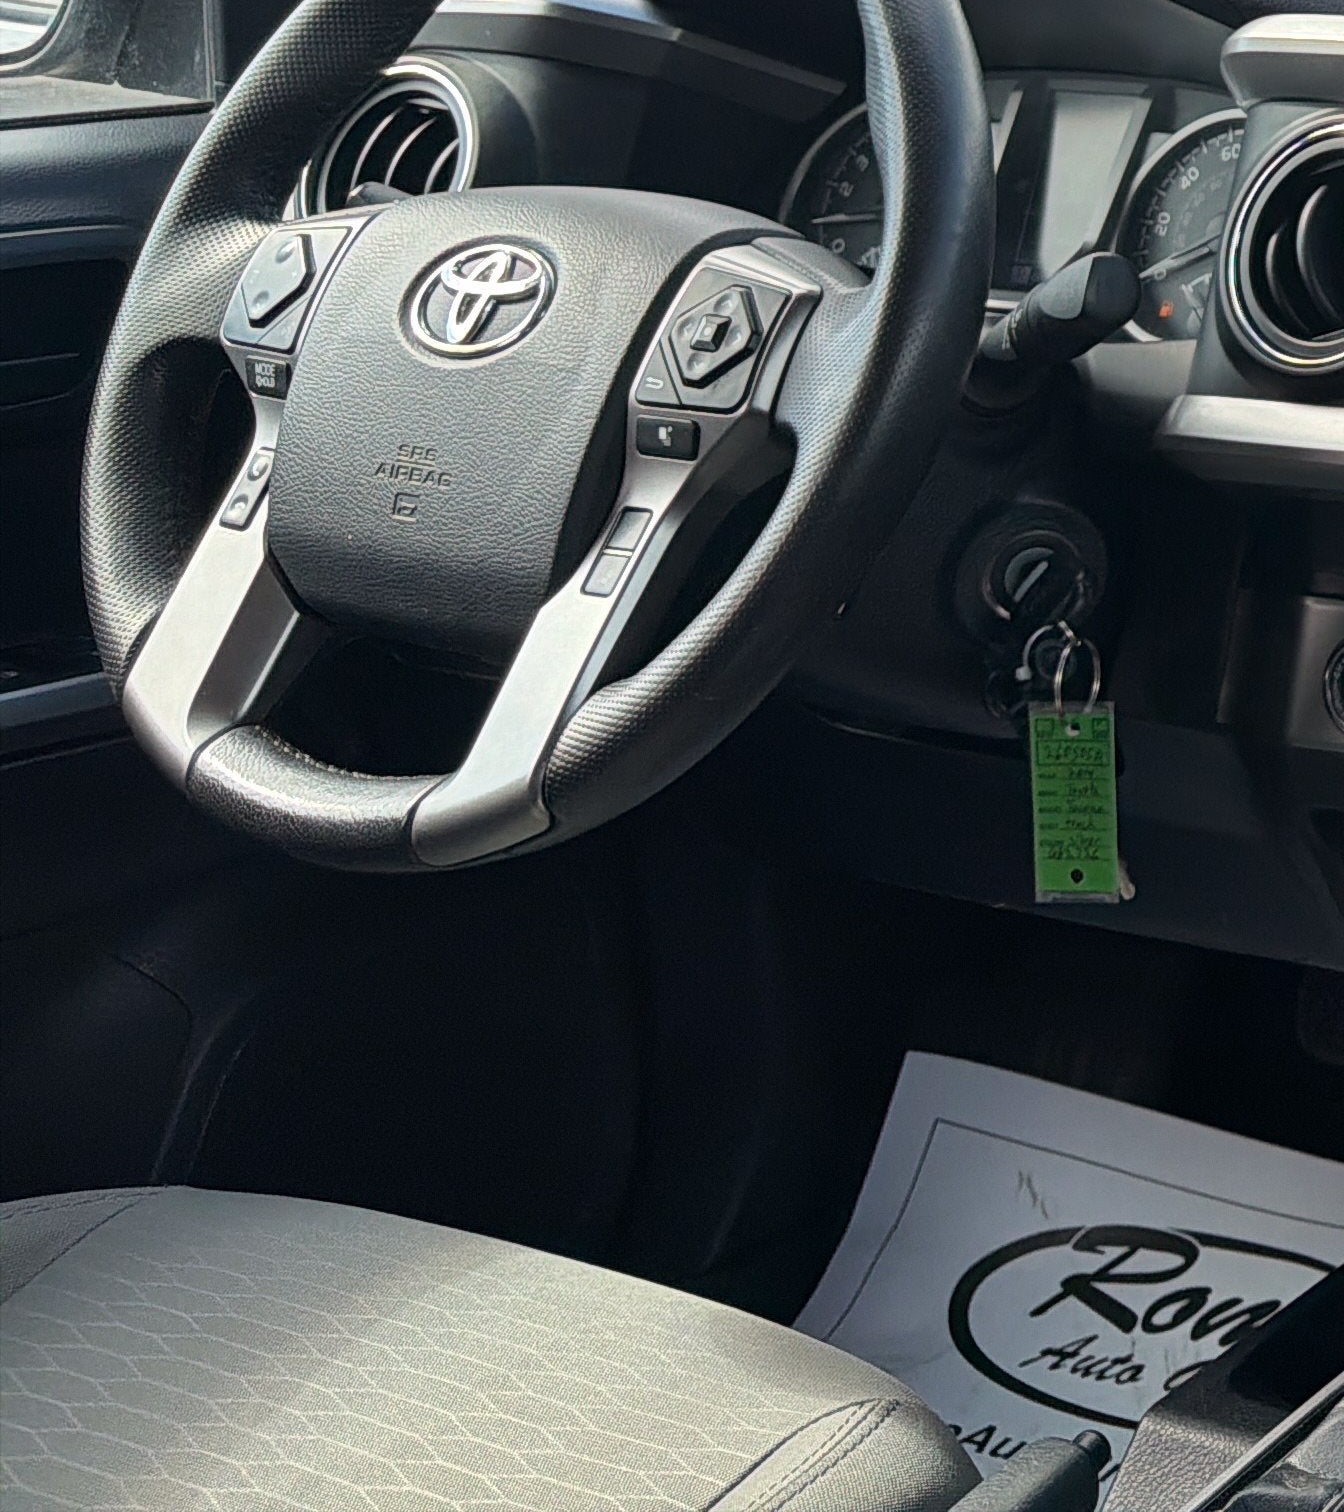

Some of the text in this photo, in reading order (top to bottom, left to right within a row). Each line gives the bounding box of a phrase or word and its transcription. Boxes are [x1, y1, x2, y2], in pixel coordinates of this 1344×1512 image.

[1220, 142, 1240, 162] 60
[855, 153, 869, 173] 3
[1179, 166, 1200, 191] 40
[838, 180, 855, 198] 2
[1154, 211, 1171, 237] 20
[831, 237, 846, 255] 0
[254, 361, 276, 377] MODE
[397, 443, 439, 462] SRS
[374, 461, 453, 487] AIRBAG
[1018, 1333, 1146, 1387] Auto
